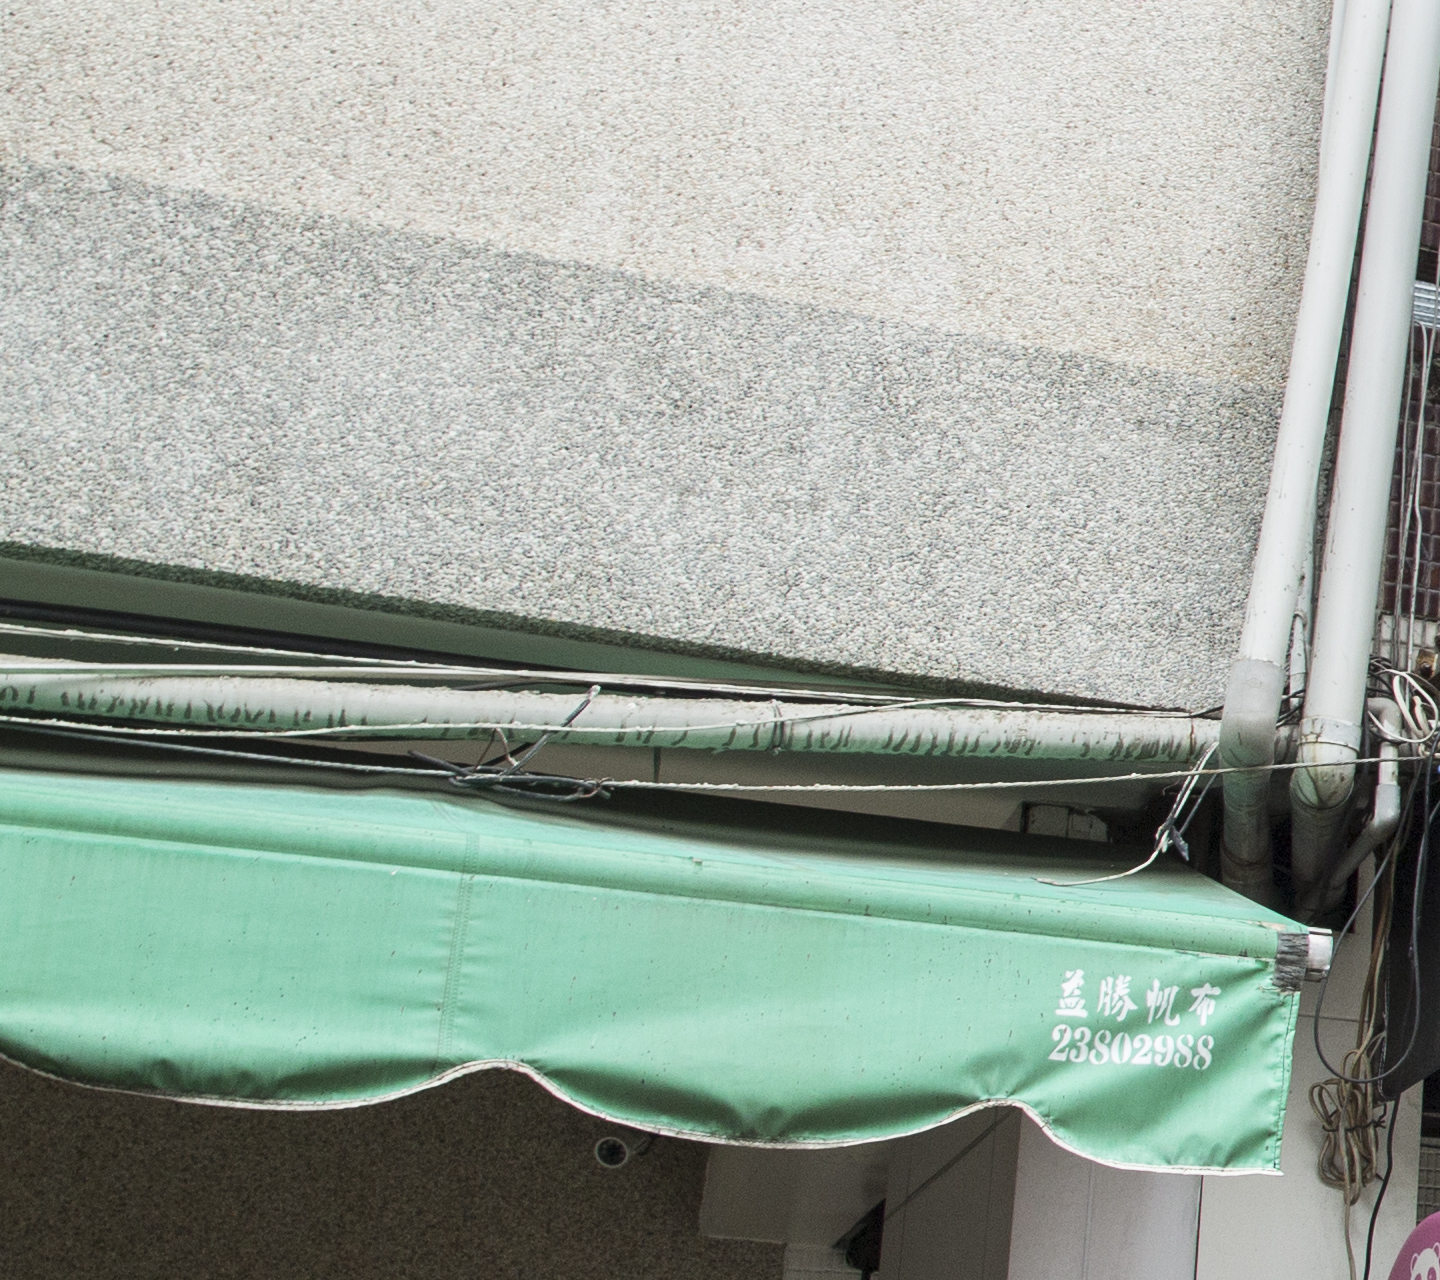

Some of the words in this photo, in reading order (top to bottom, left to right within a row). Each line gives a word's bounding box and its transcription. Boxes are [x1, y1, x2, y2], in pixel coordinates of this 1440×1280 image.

[1055, 969, 1221, 1026] 益勝帆布
[1048, 1024, 1214, 1070] 23802988
